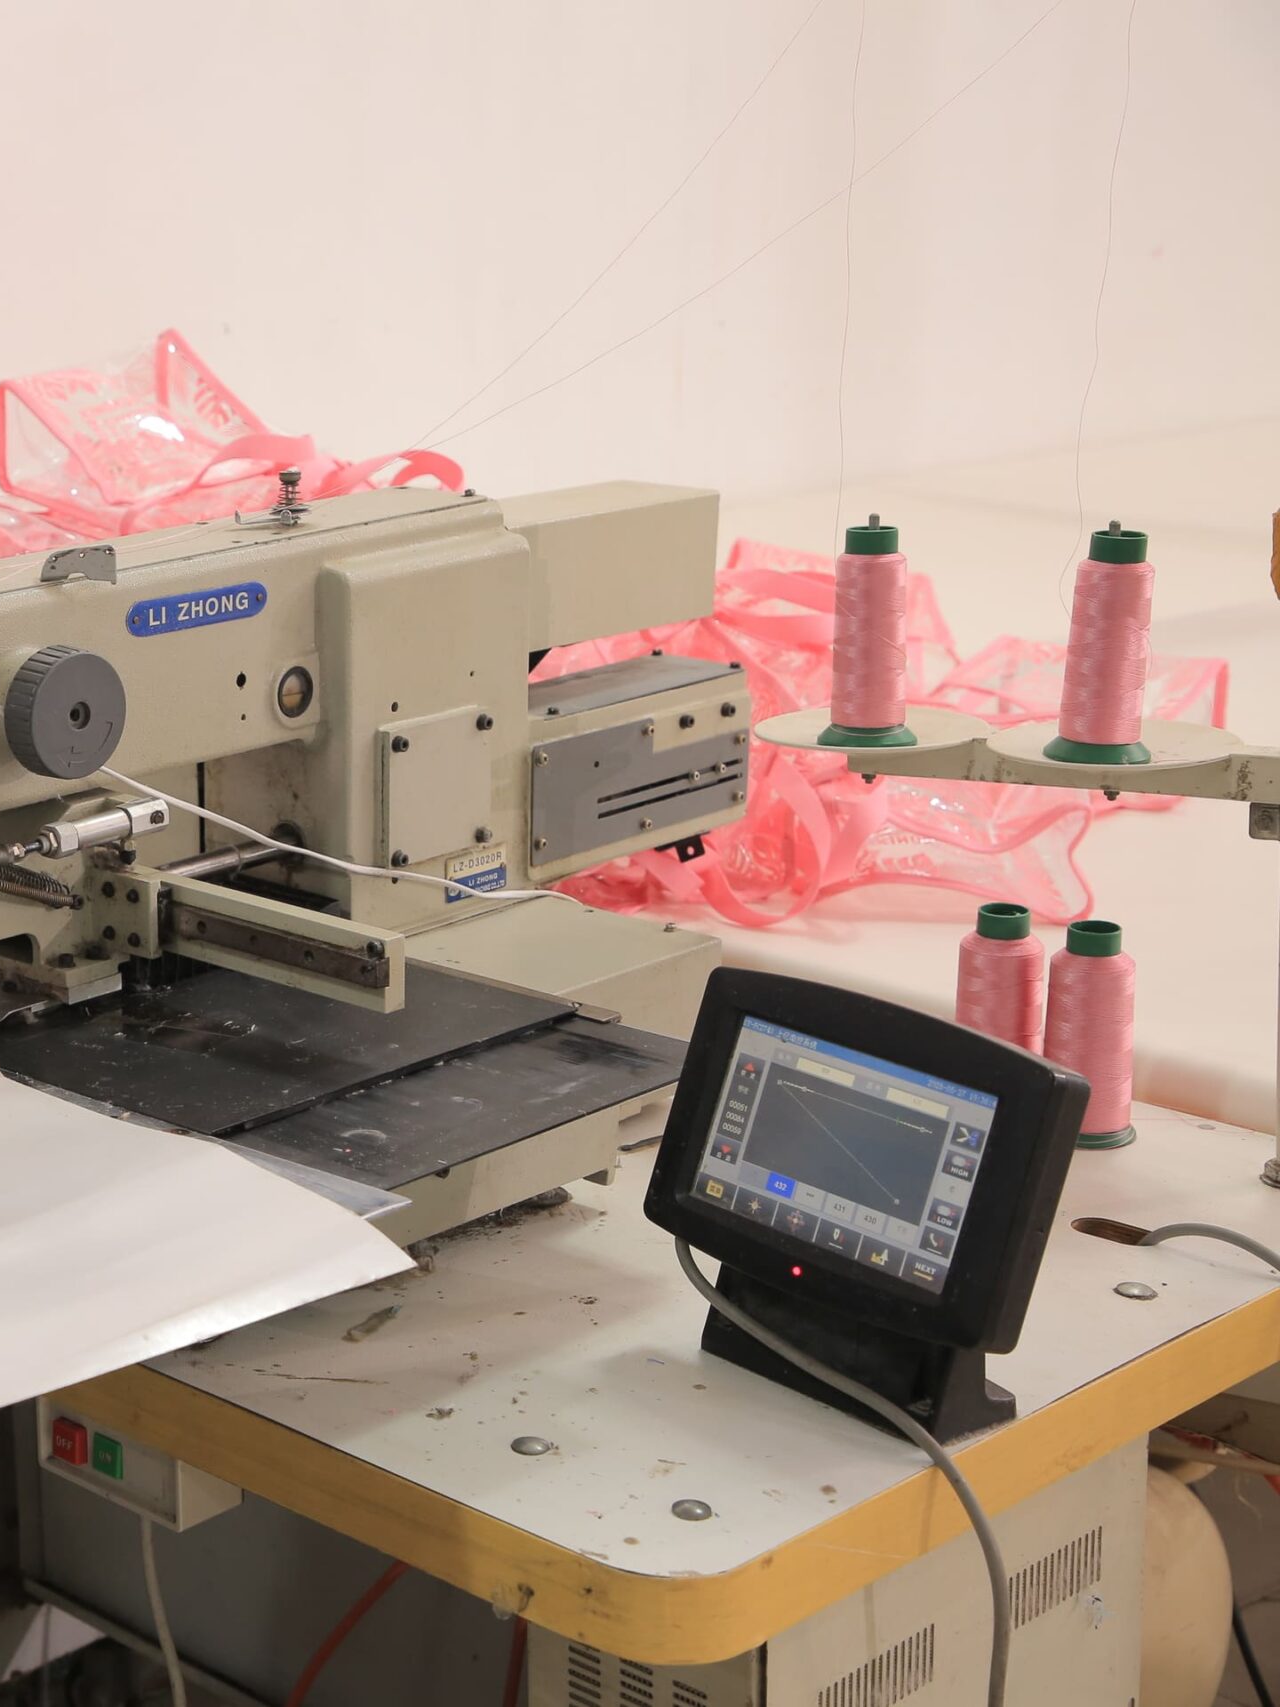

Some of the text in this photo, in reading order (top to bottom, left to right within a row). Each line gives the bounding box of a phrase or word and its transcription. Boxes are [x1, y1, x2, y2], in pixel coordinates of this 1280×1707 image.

[149, 592, 249, 626] LI ZHONG
[468, 872, 498, 887] LI ZHONG
[950, 1166, 969, 1178] HIGH
[773, 1181, 787, 1191] 432
[833, 1203, 846, 1214] 431
[863, 1215, 877, 1225] 430
[936, 1216, 953, 1227] LOW
[914, 1262, 937, 1276] NEXT
[56, 1435, 73, 1450] OFF
[98, 1450, 112, 1463] ON
